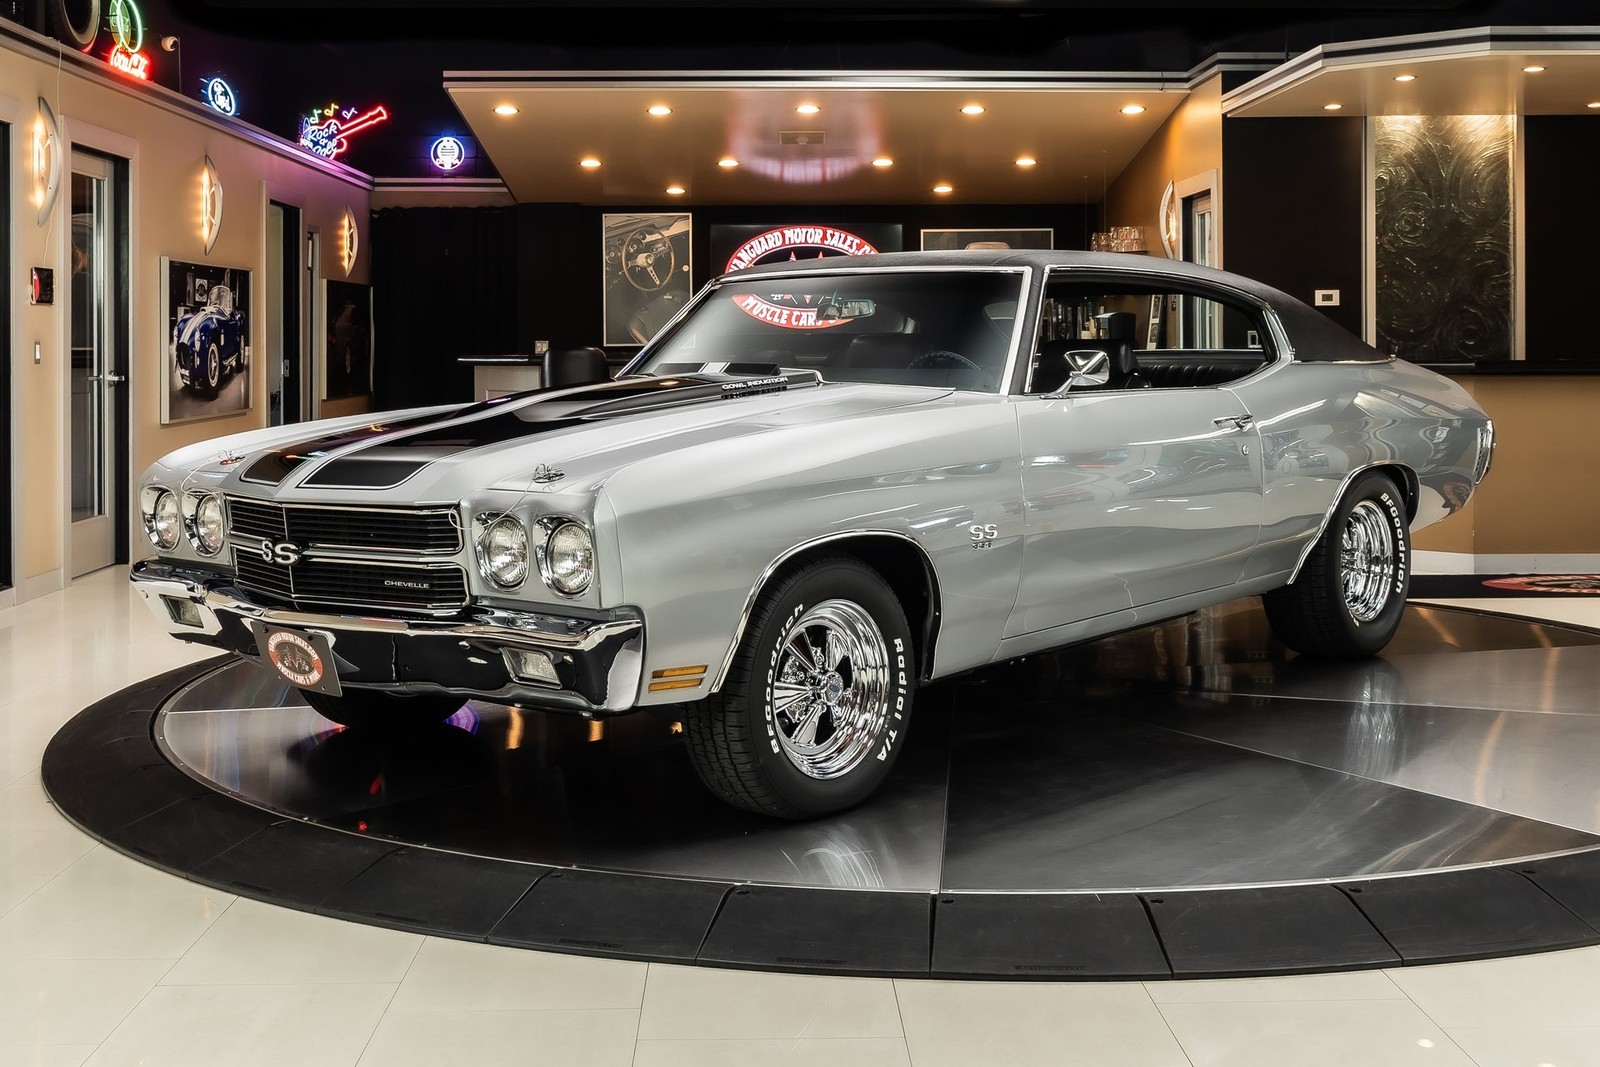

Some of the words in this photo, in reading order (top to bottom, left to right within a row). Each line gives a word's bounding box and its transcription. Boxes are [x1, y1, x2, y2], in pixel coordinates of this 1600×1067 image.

[308, 121, 338, 143] Rock
[783, 228, 823, 245] MOTOR
[740, 295, 788, 327] MUSCLE
[721, 383, 747, 391] COWL
[747, 376, 789, 387] INDUCTION
[968, 523, 998, 541] SS
[1380, 492, 1405, 594] BFGoodrich
[261, 540, 299, 565] SS
[384, 580, 430, 589] CHEVELLE
[765, 603, 804, 754] BFGoodrich
[893, 638, 907, 720] Radial
[876, 729, 898, 761] T/A
